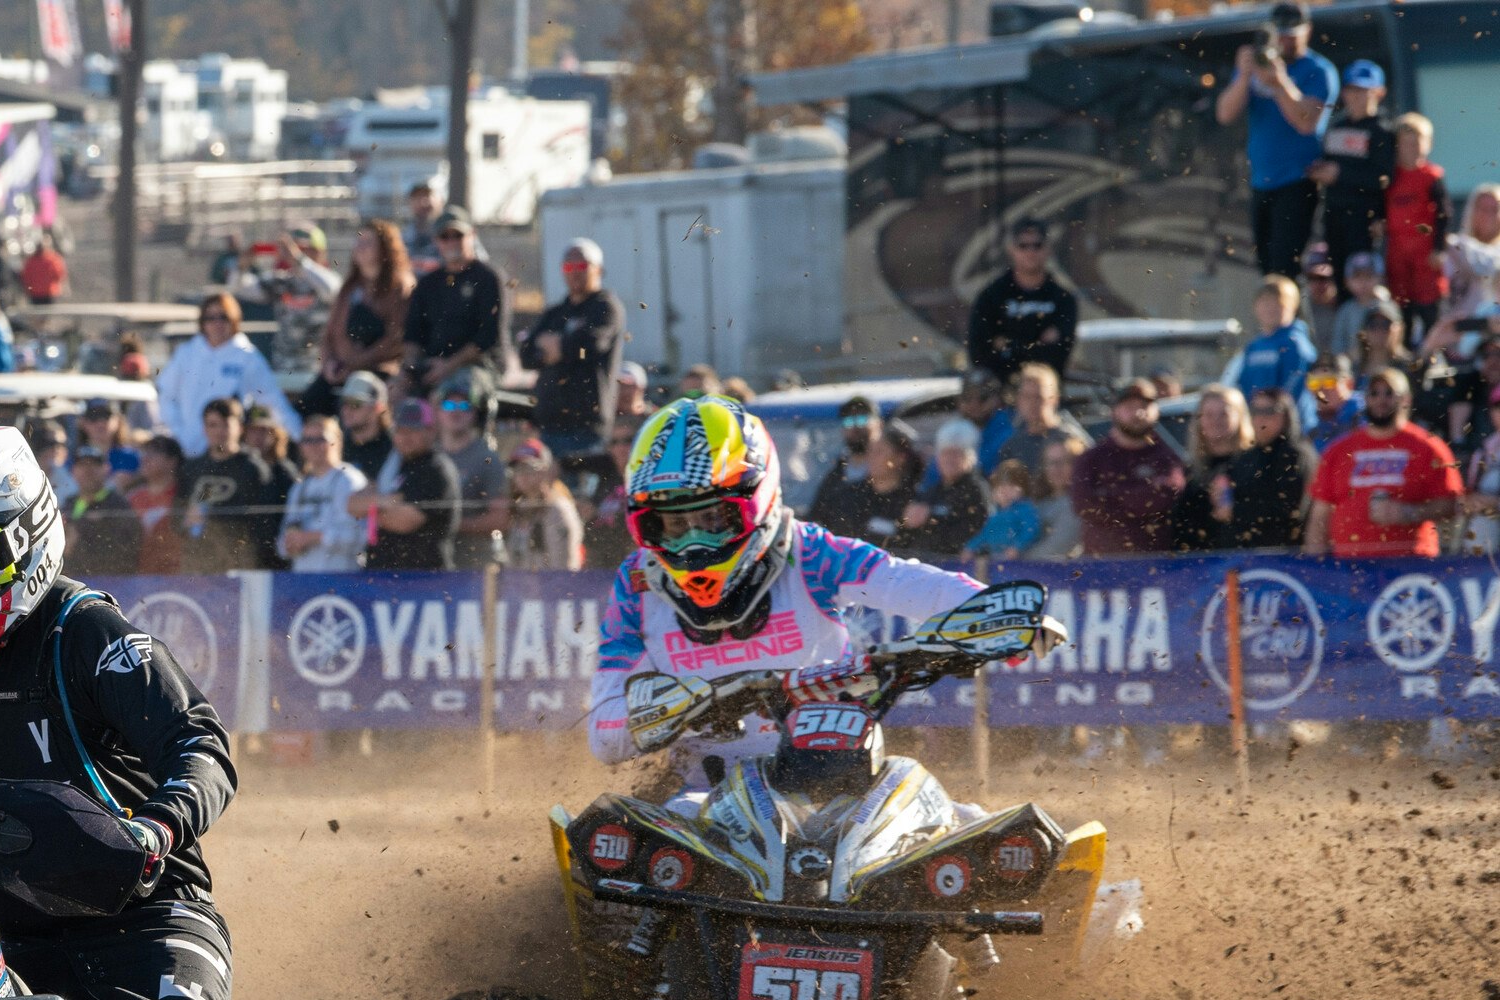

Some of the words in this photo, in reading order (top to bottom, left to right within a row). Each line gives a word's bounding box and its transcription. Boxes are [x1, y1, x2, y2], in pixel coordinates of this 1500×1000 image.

[27, 552, 53, 597] 004
[984, 589, 1035, 615] 510
[373, 600, 599, 680] YAMAH
[669, 631, 804, 673] RACING
[317, 690, 566, 712] RACIN
[793, 708, 869, 738] 510
[593, 833, 630, 861] 510
[999, 846, 1035, 871] 510
[784, 946, 864, 963] JENKINS
